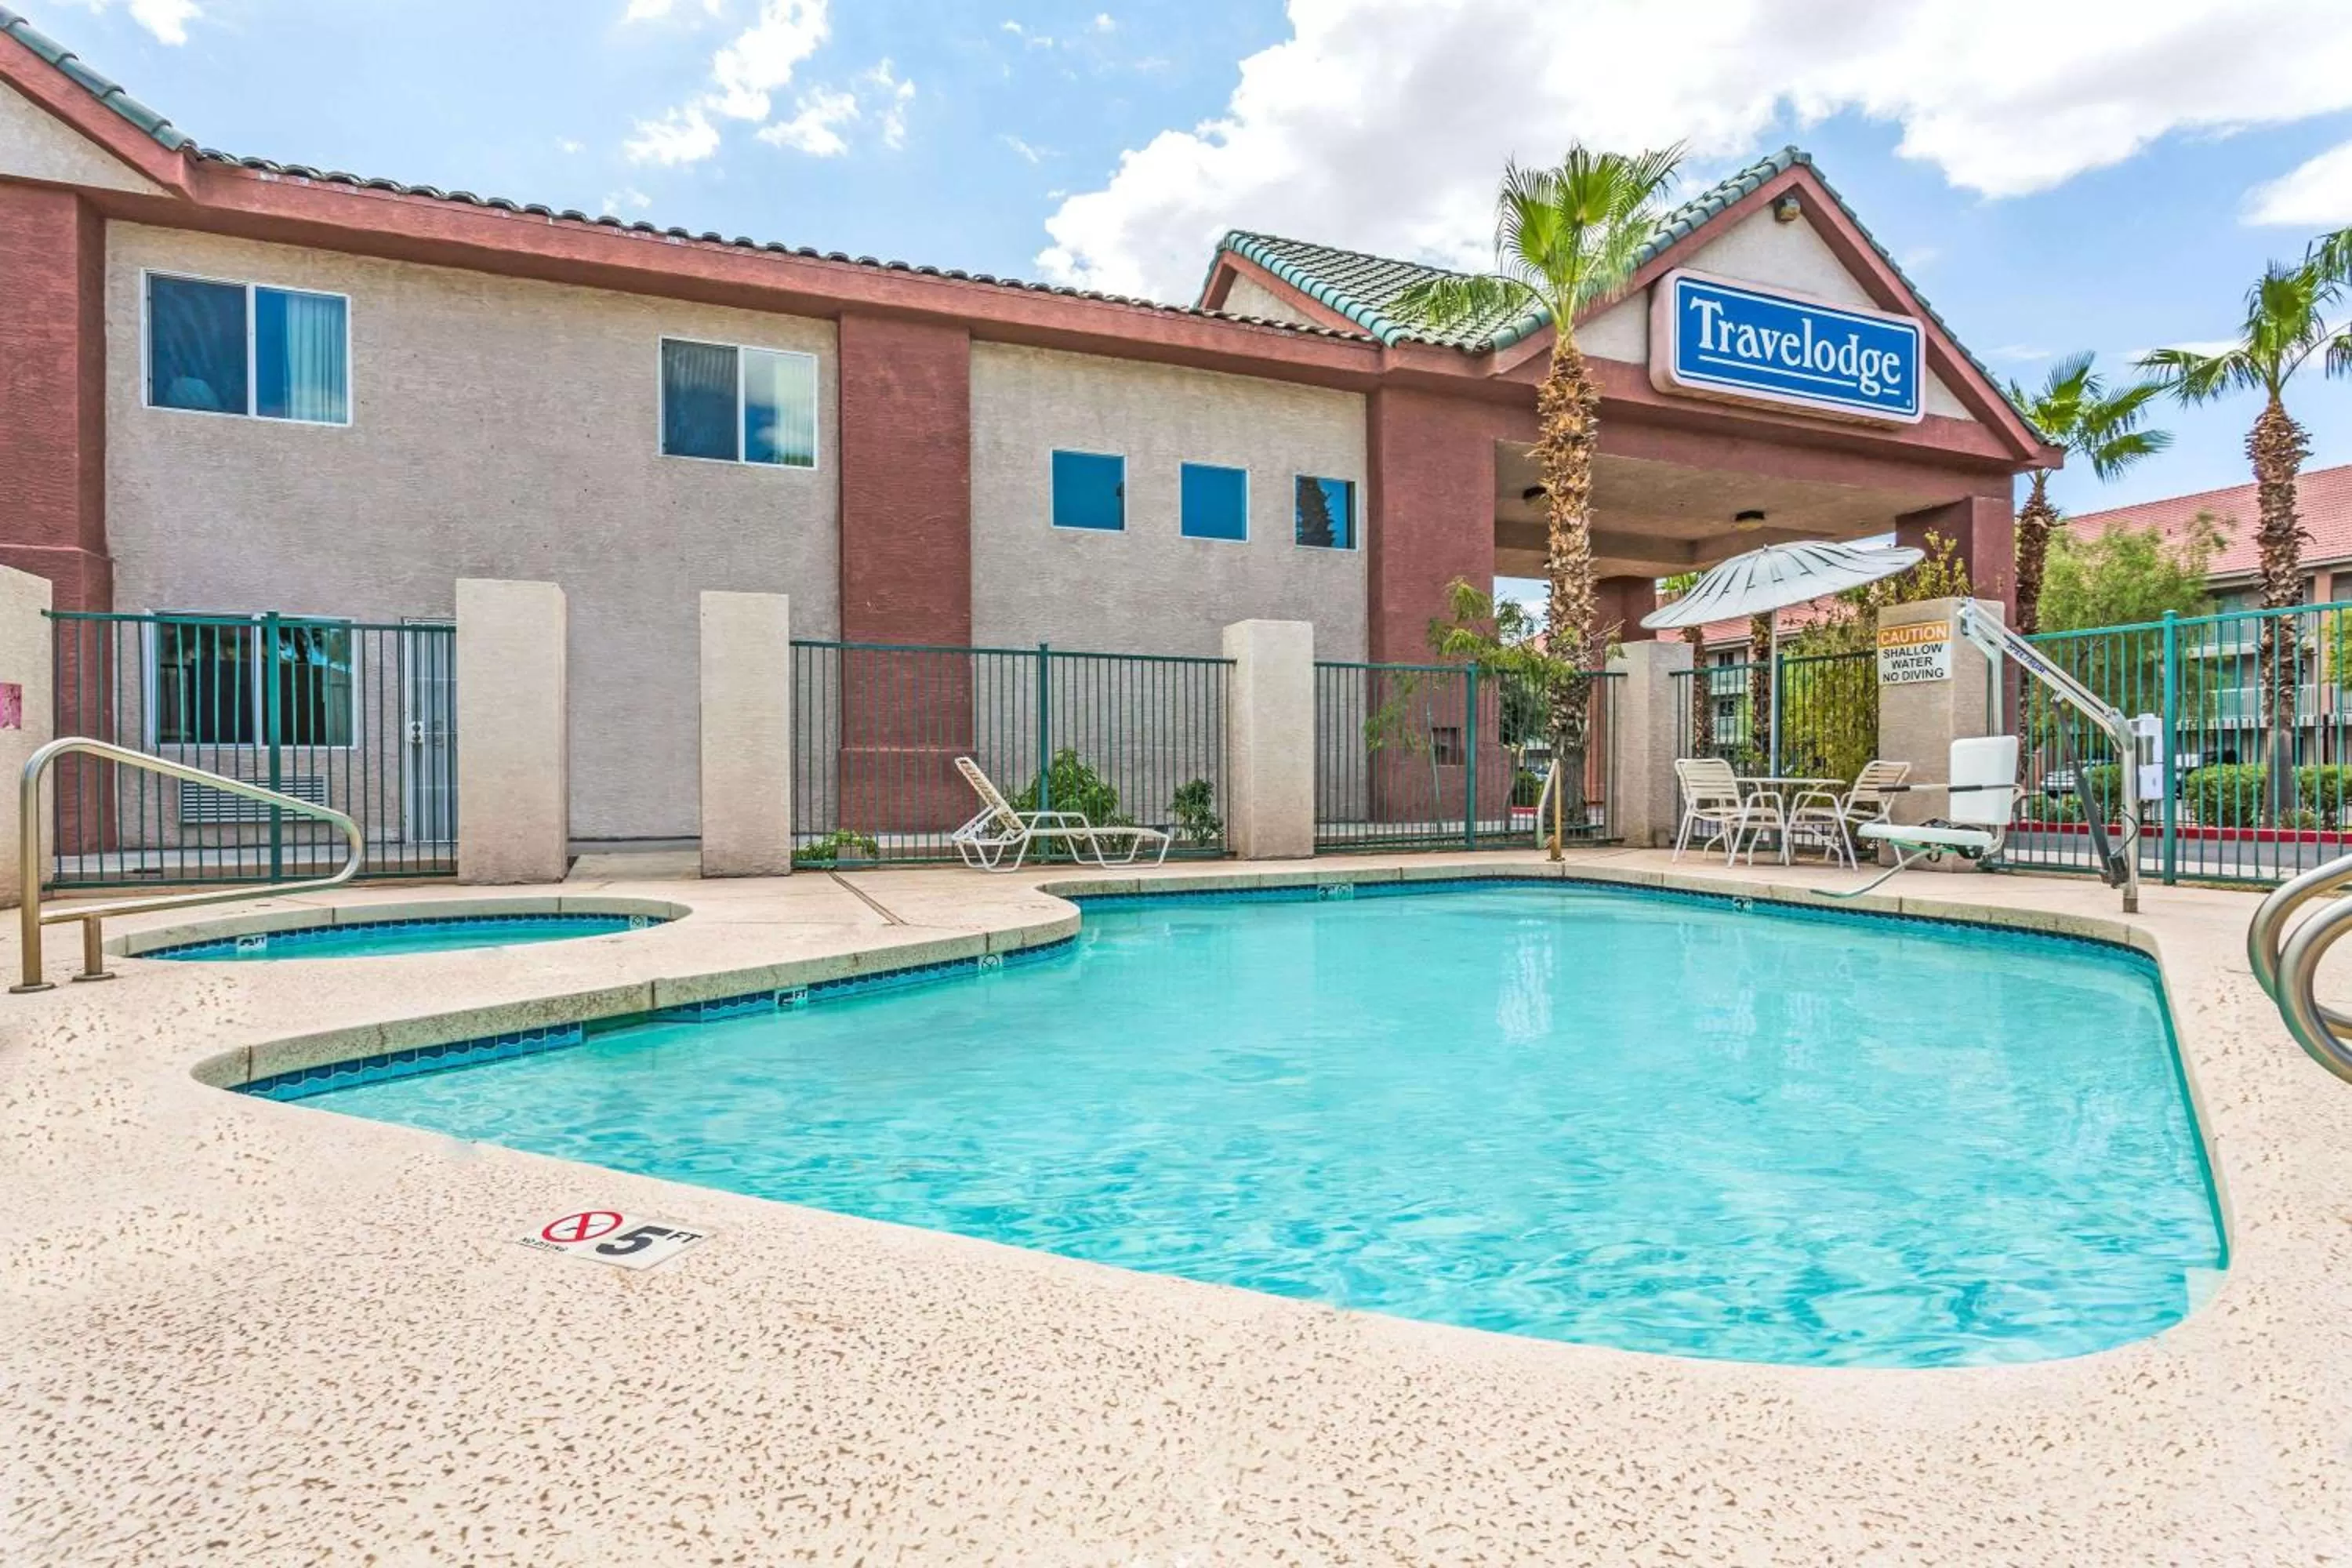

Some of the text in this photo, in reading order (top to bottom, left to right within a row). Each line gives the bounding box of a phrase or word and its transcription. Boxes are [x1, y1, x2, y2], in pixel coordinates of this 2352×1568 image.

[1690, 296, 1901, 397] Travelodge
[1881, 625, 1947, 644] CAUTION
[1882, 643, 1943, 659] SHALLOW
[1891, 656, 1933, 670] WATER
[1882, 667, 1944, 682] NO DIVING
[596, 1225, 703, 1255] 5 FT
